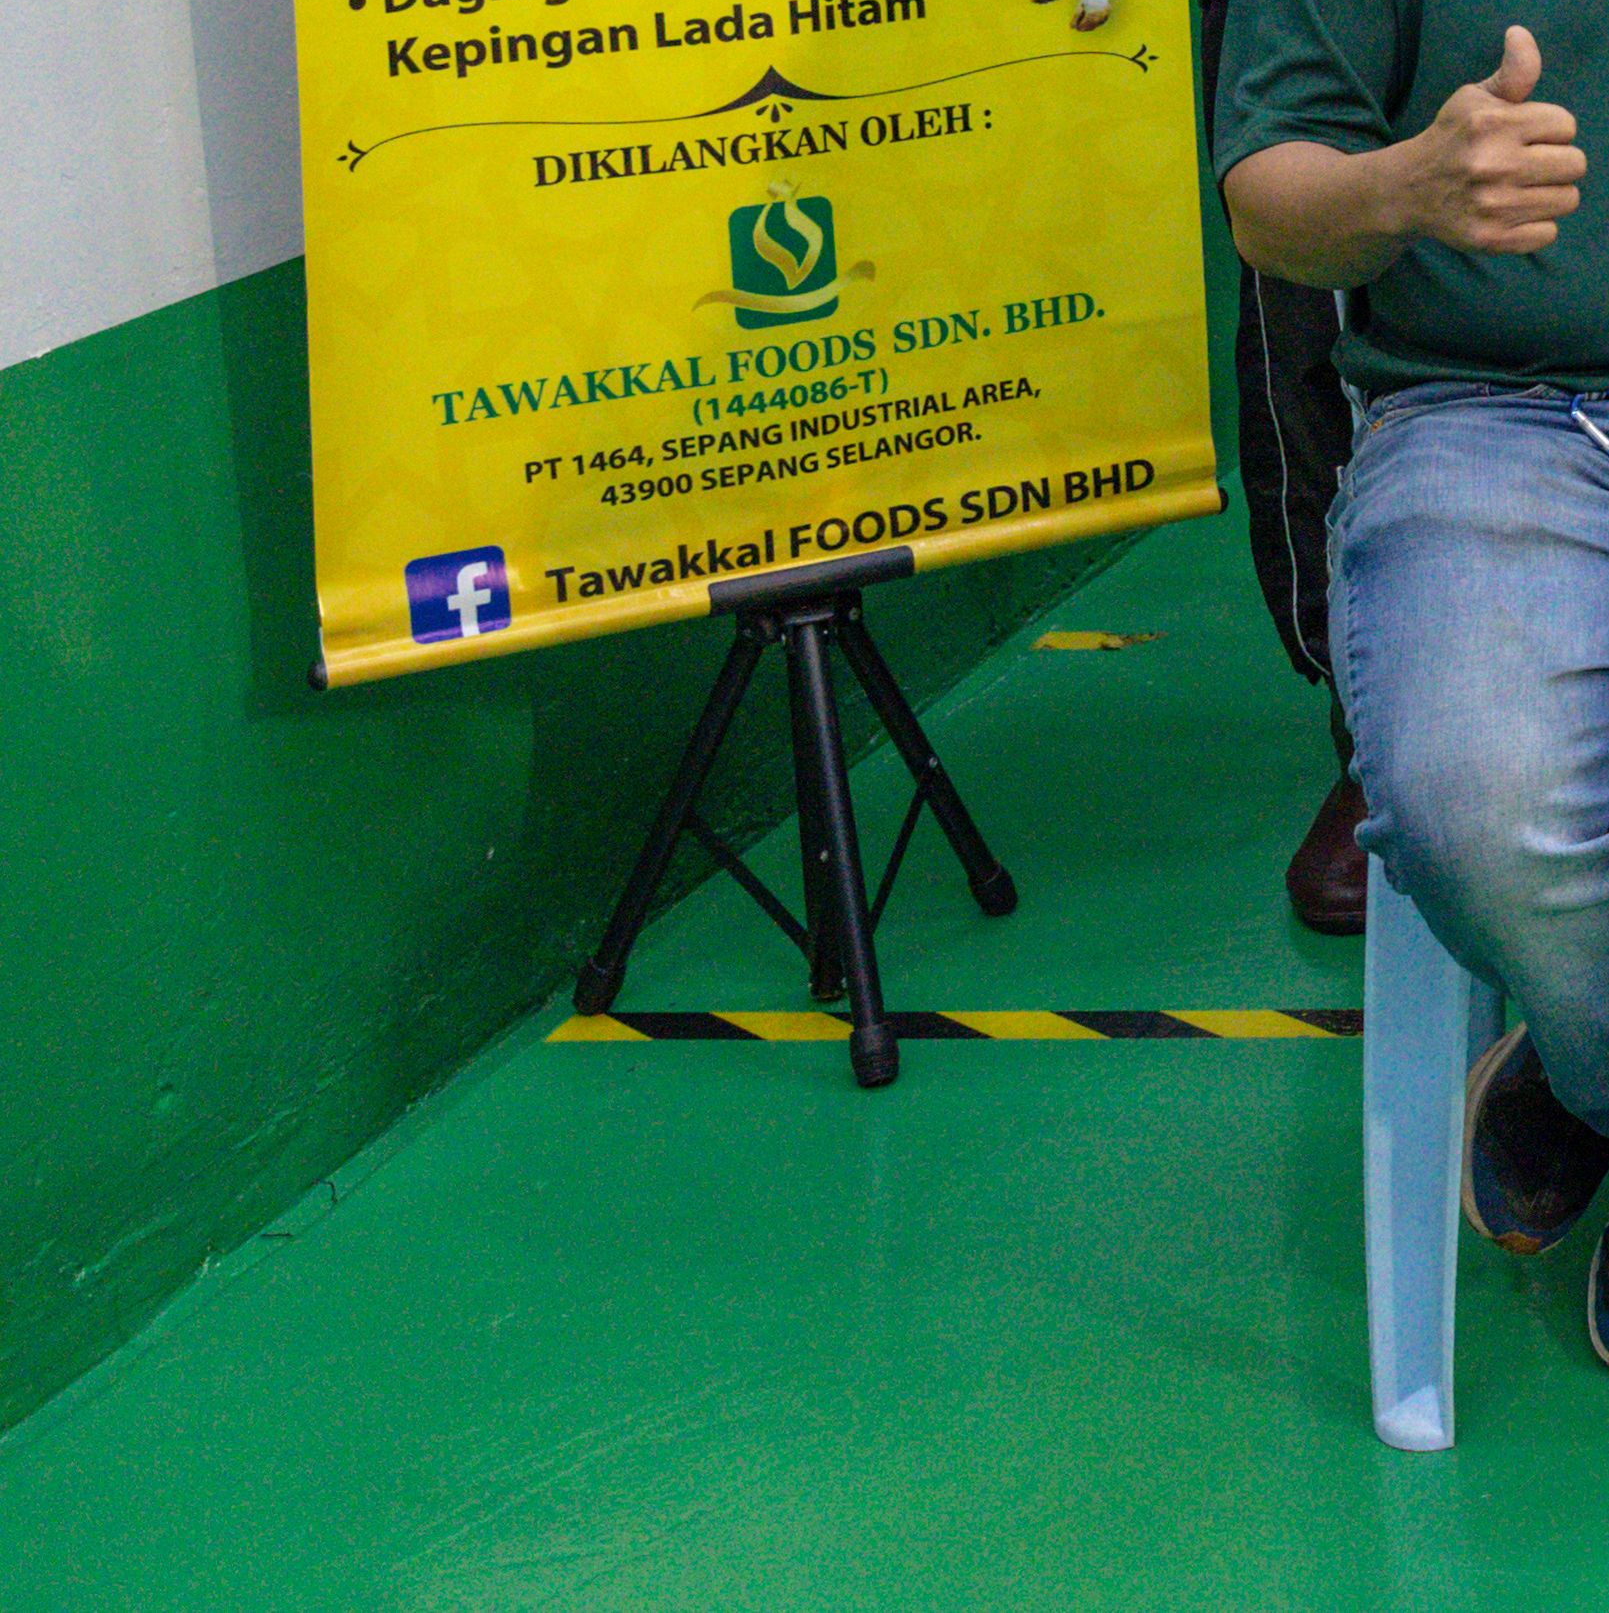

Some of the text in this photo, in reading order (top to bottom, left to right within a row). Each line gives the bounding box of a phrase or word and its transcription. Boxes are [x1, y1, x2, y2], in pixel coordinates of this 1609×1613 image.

[388, 25, 638, 78] Kepingan
[655, 4, 773, 48] Lada
[534, 121, 848, 187] DIKILANGKAN
[861, 104, 972, 146] OLEH
[432, 293, 1104, 426] TAWAKKAL FOODS SDN. BHD.
[693, 368, 893, 430] (1444086-T)
[525, 378, 1040, 483] PT 1464, SEPANG INDUSTRIAL AREA,
[601, 422, 982, 506] 43900 SEPANG SELANGOR.
[545, 460, 1155, 602] Tawakkal FOODS SDN BHD
